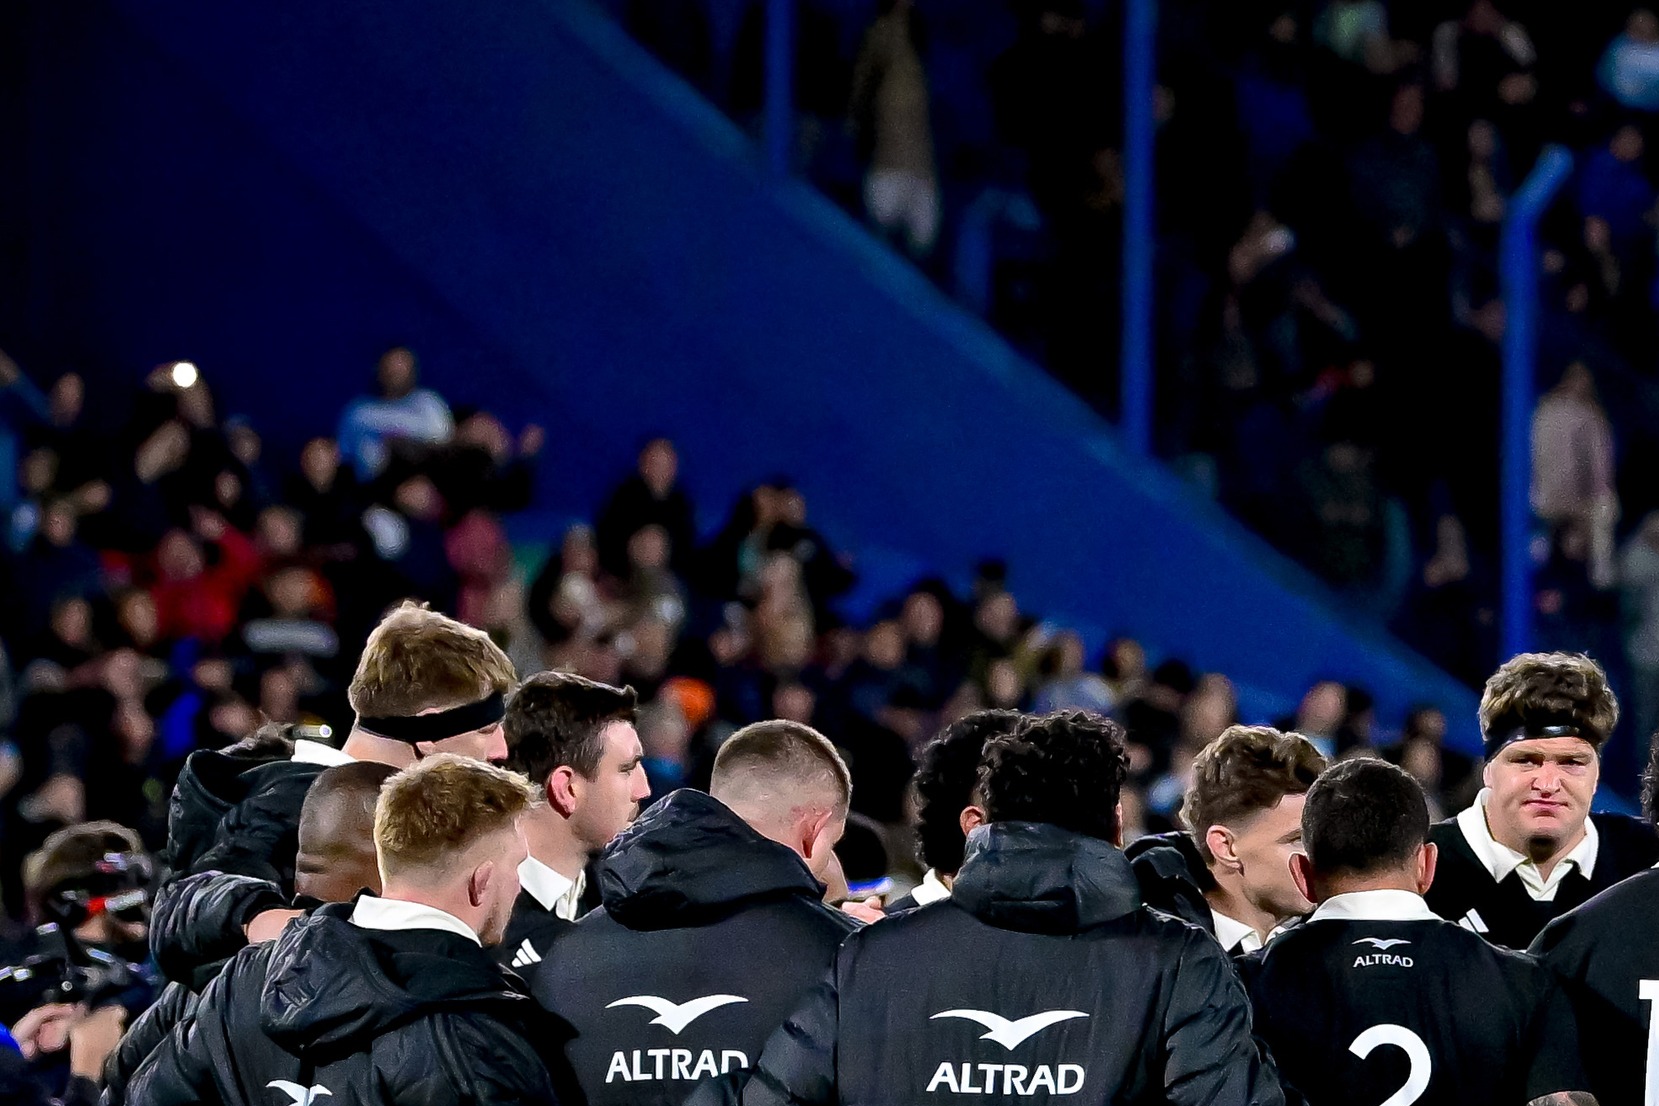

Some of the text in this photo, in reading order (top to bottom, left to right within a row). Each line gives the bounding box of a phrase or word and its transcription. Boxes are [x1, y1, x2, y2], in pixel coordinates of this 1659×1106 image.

[1352, 953, 1414, 968] ALTRAD
[605, 1048, 749, 1083] ALTRAD
[925, 1061, 1086, 1096] ALTRAD
